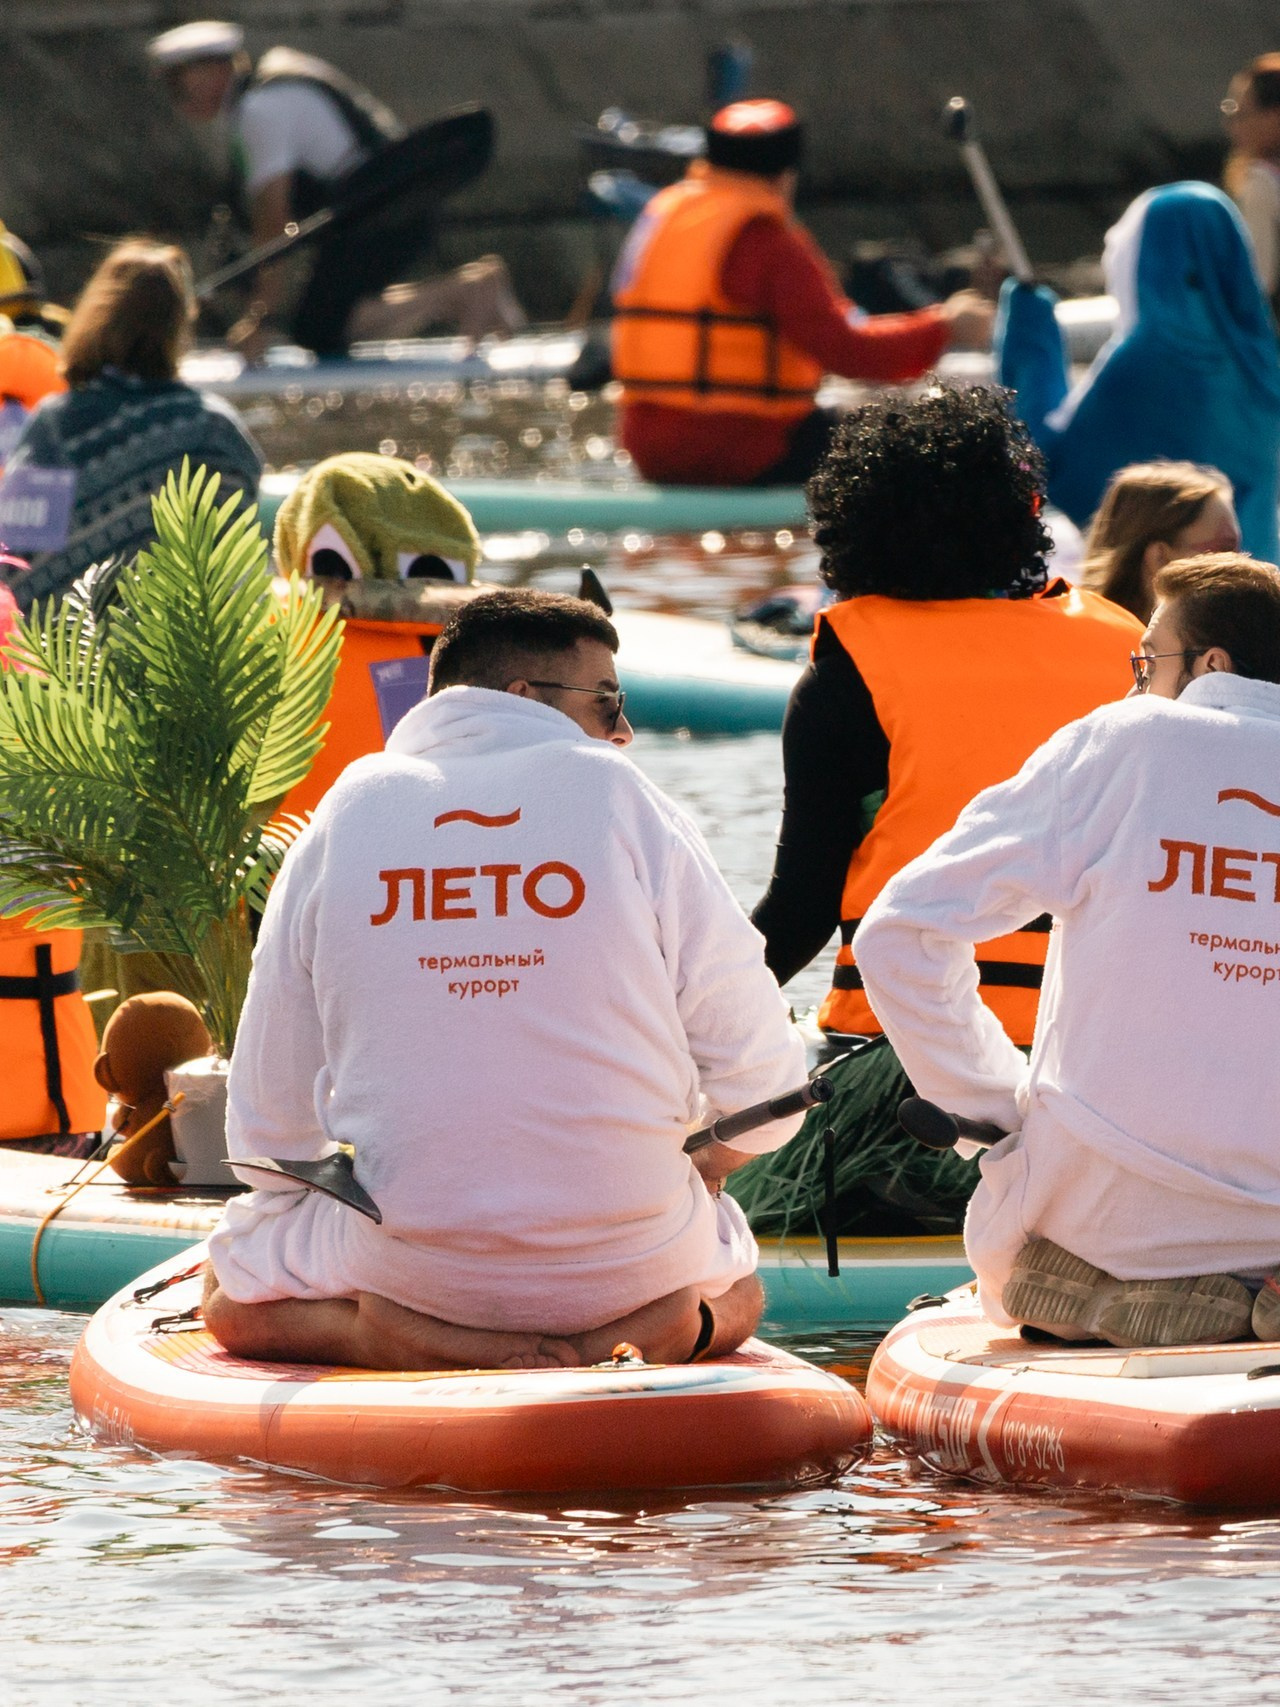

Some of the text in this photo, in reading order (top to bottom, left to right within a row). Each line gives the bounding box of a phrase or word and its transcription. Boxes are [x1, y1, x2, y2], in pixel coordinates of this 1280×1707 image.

[370, 861, 586, 926] ЛЕТО
[418, 949, 545, 974] термальный
[447, 979, 520, 1000] курорт
